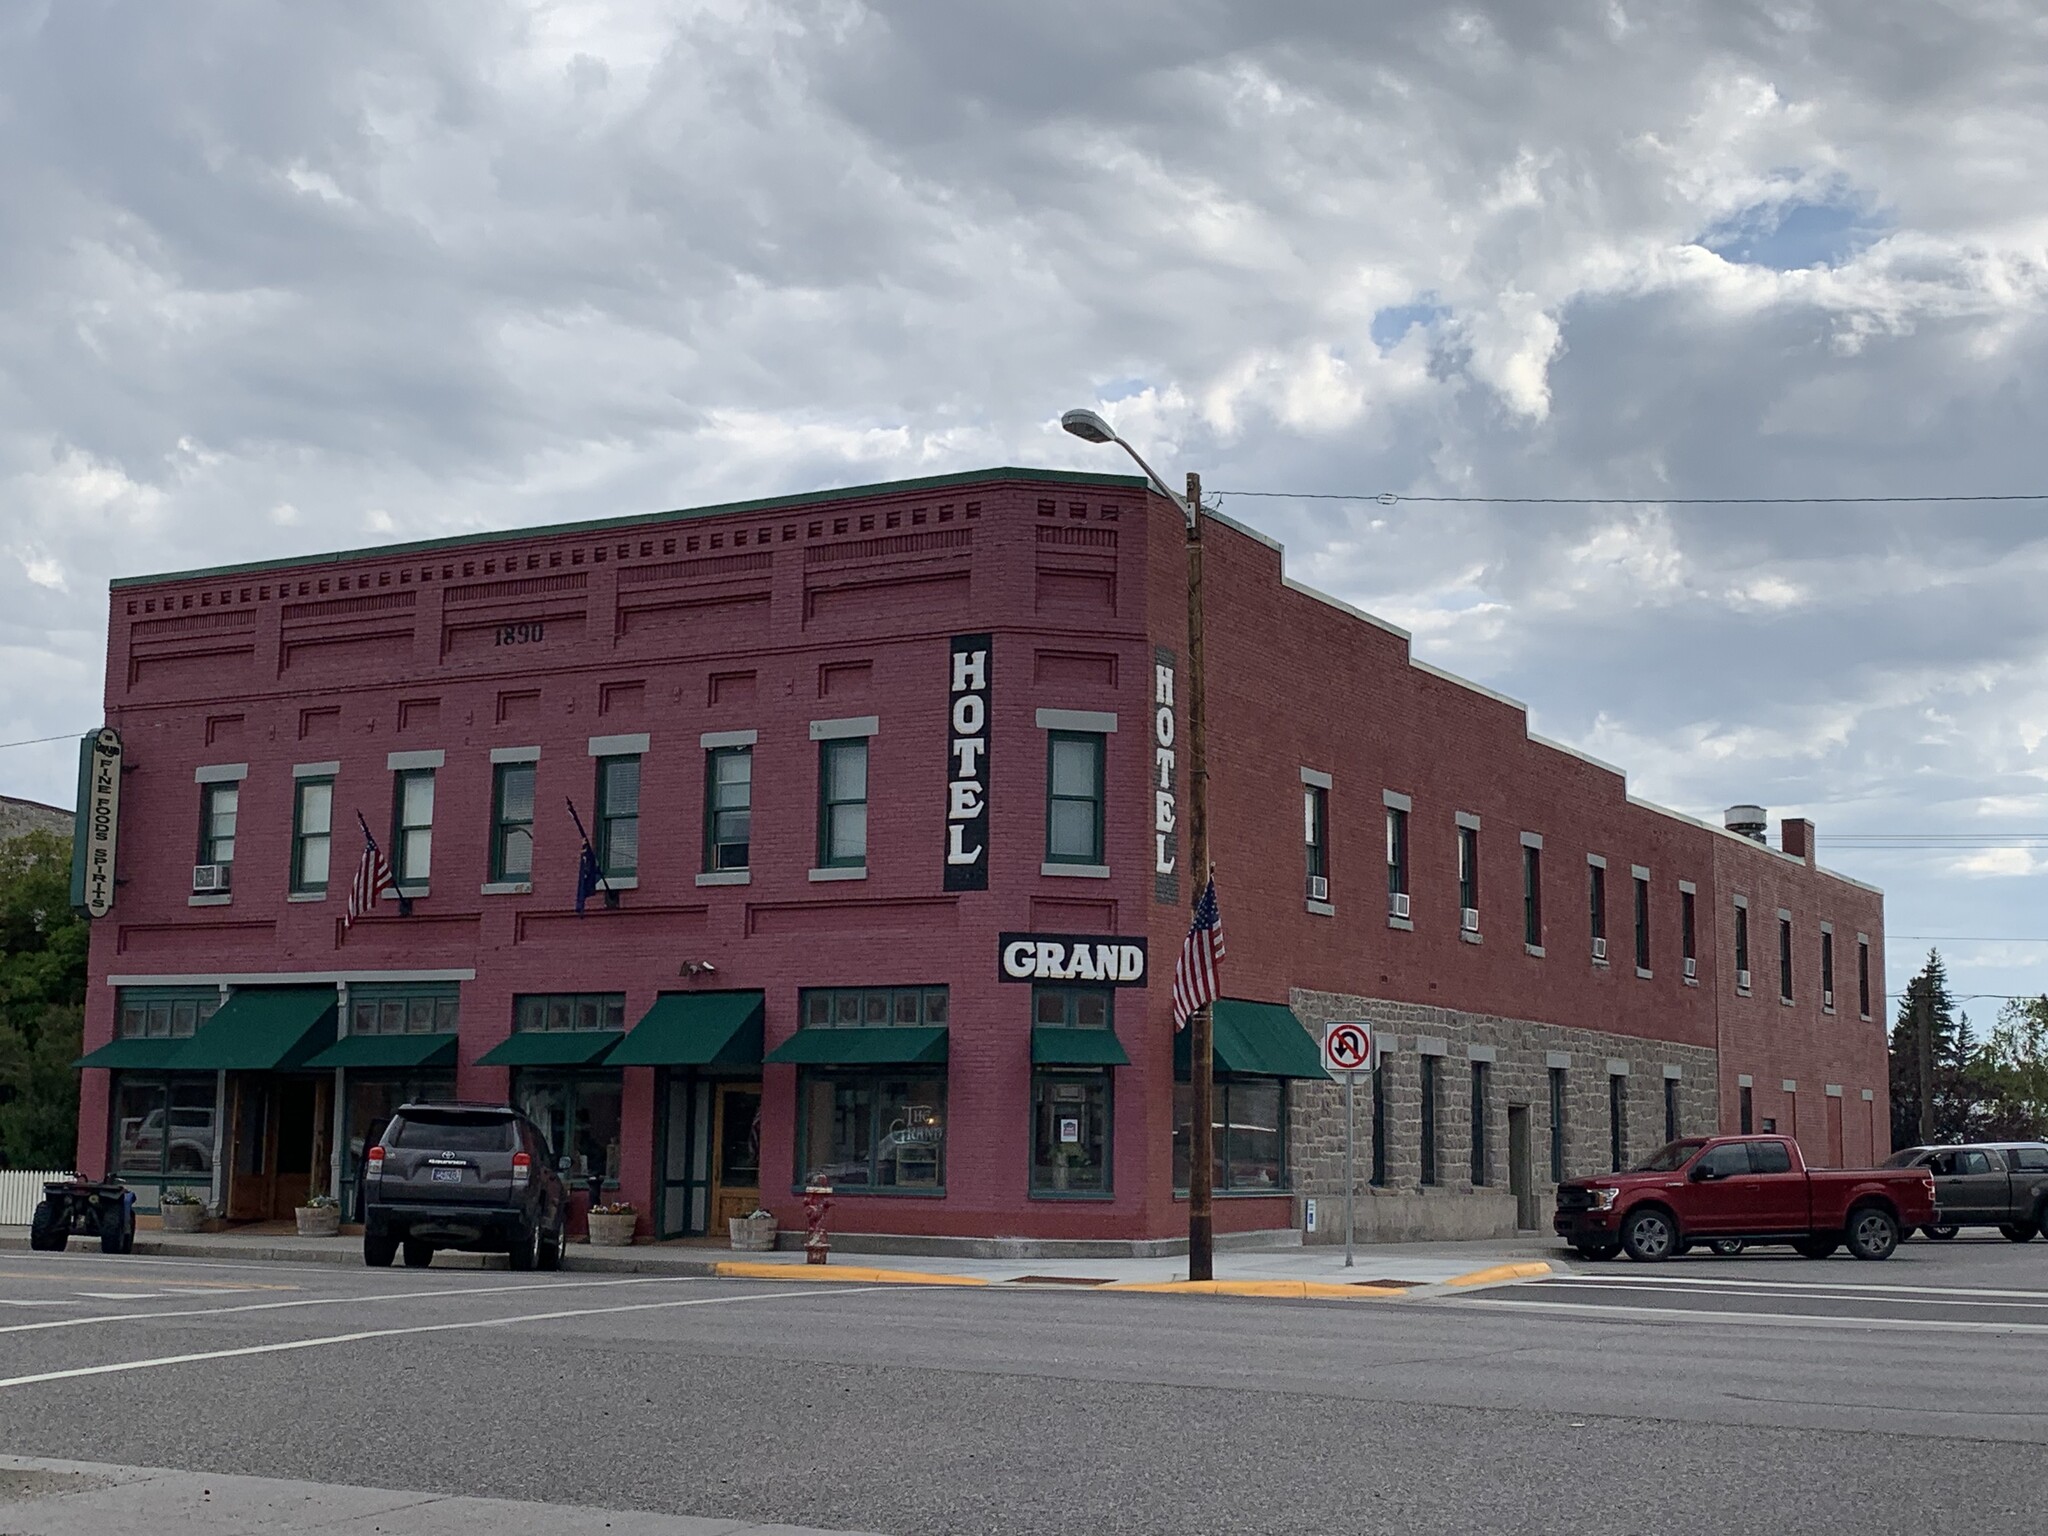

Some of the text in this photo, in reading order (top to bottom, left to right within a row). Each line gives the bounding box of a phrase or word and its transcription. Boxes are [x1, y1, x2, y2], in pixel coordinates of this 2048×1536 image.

[494, 622, 544, 647] 1890
[97, 759, 113, 795] FINE
[947, 650, 987, 866] HOTEL
[1155, 665, 1176, 875] HOTEL
[95, 799, 110, 841] FOODS
[92, 849, 108, 908] SPIRITS
[1003, 941, 1143, 981] GRAND
[889, 1119, 943, 1144] GRAND
[901, 1105, 933, 1127] THE
